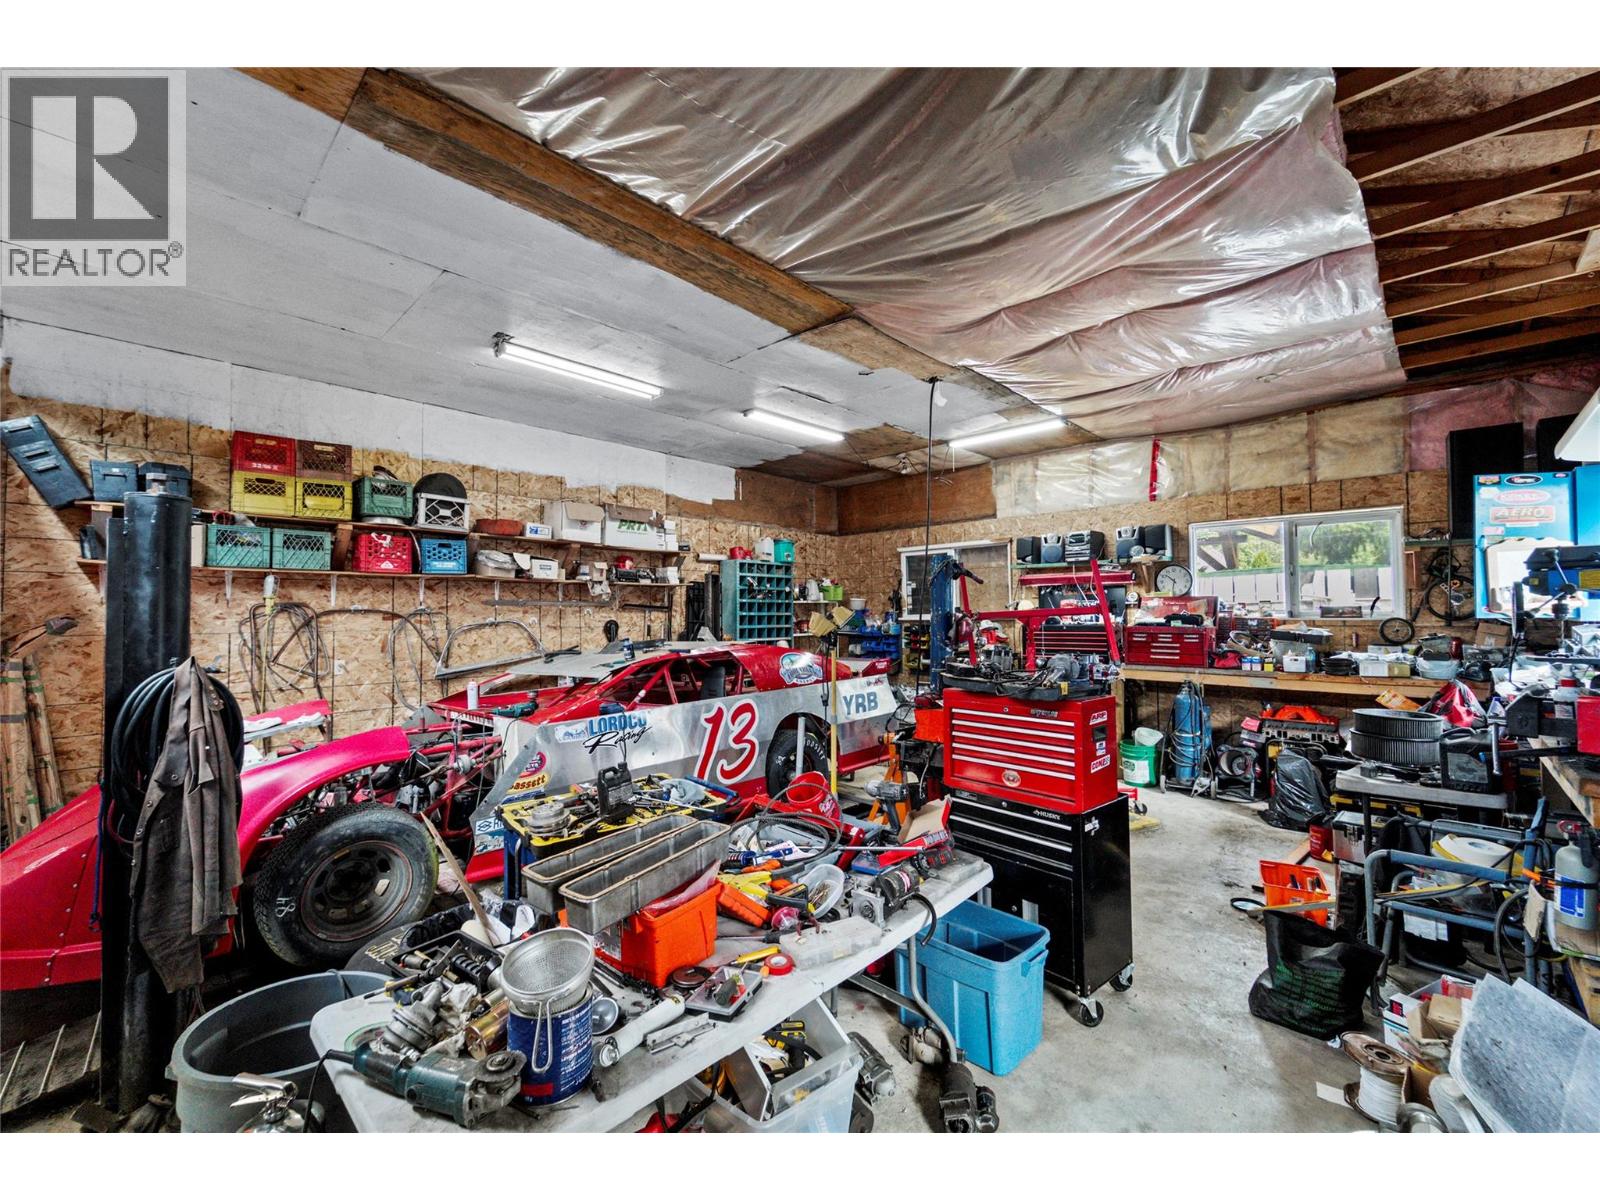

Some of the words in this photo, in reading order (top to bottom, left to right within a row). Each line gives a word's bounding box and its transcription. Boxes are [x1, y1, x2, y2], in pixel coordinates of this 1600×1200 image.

[842, 691, 879, 715] YRB
[588, 711, 647, 736] LORDCO
[583, 727, 652, 754] Racing
[694, 698, 759, 784] 13
